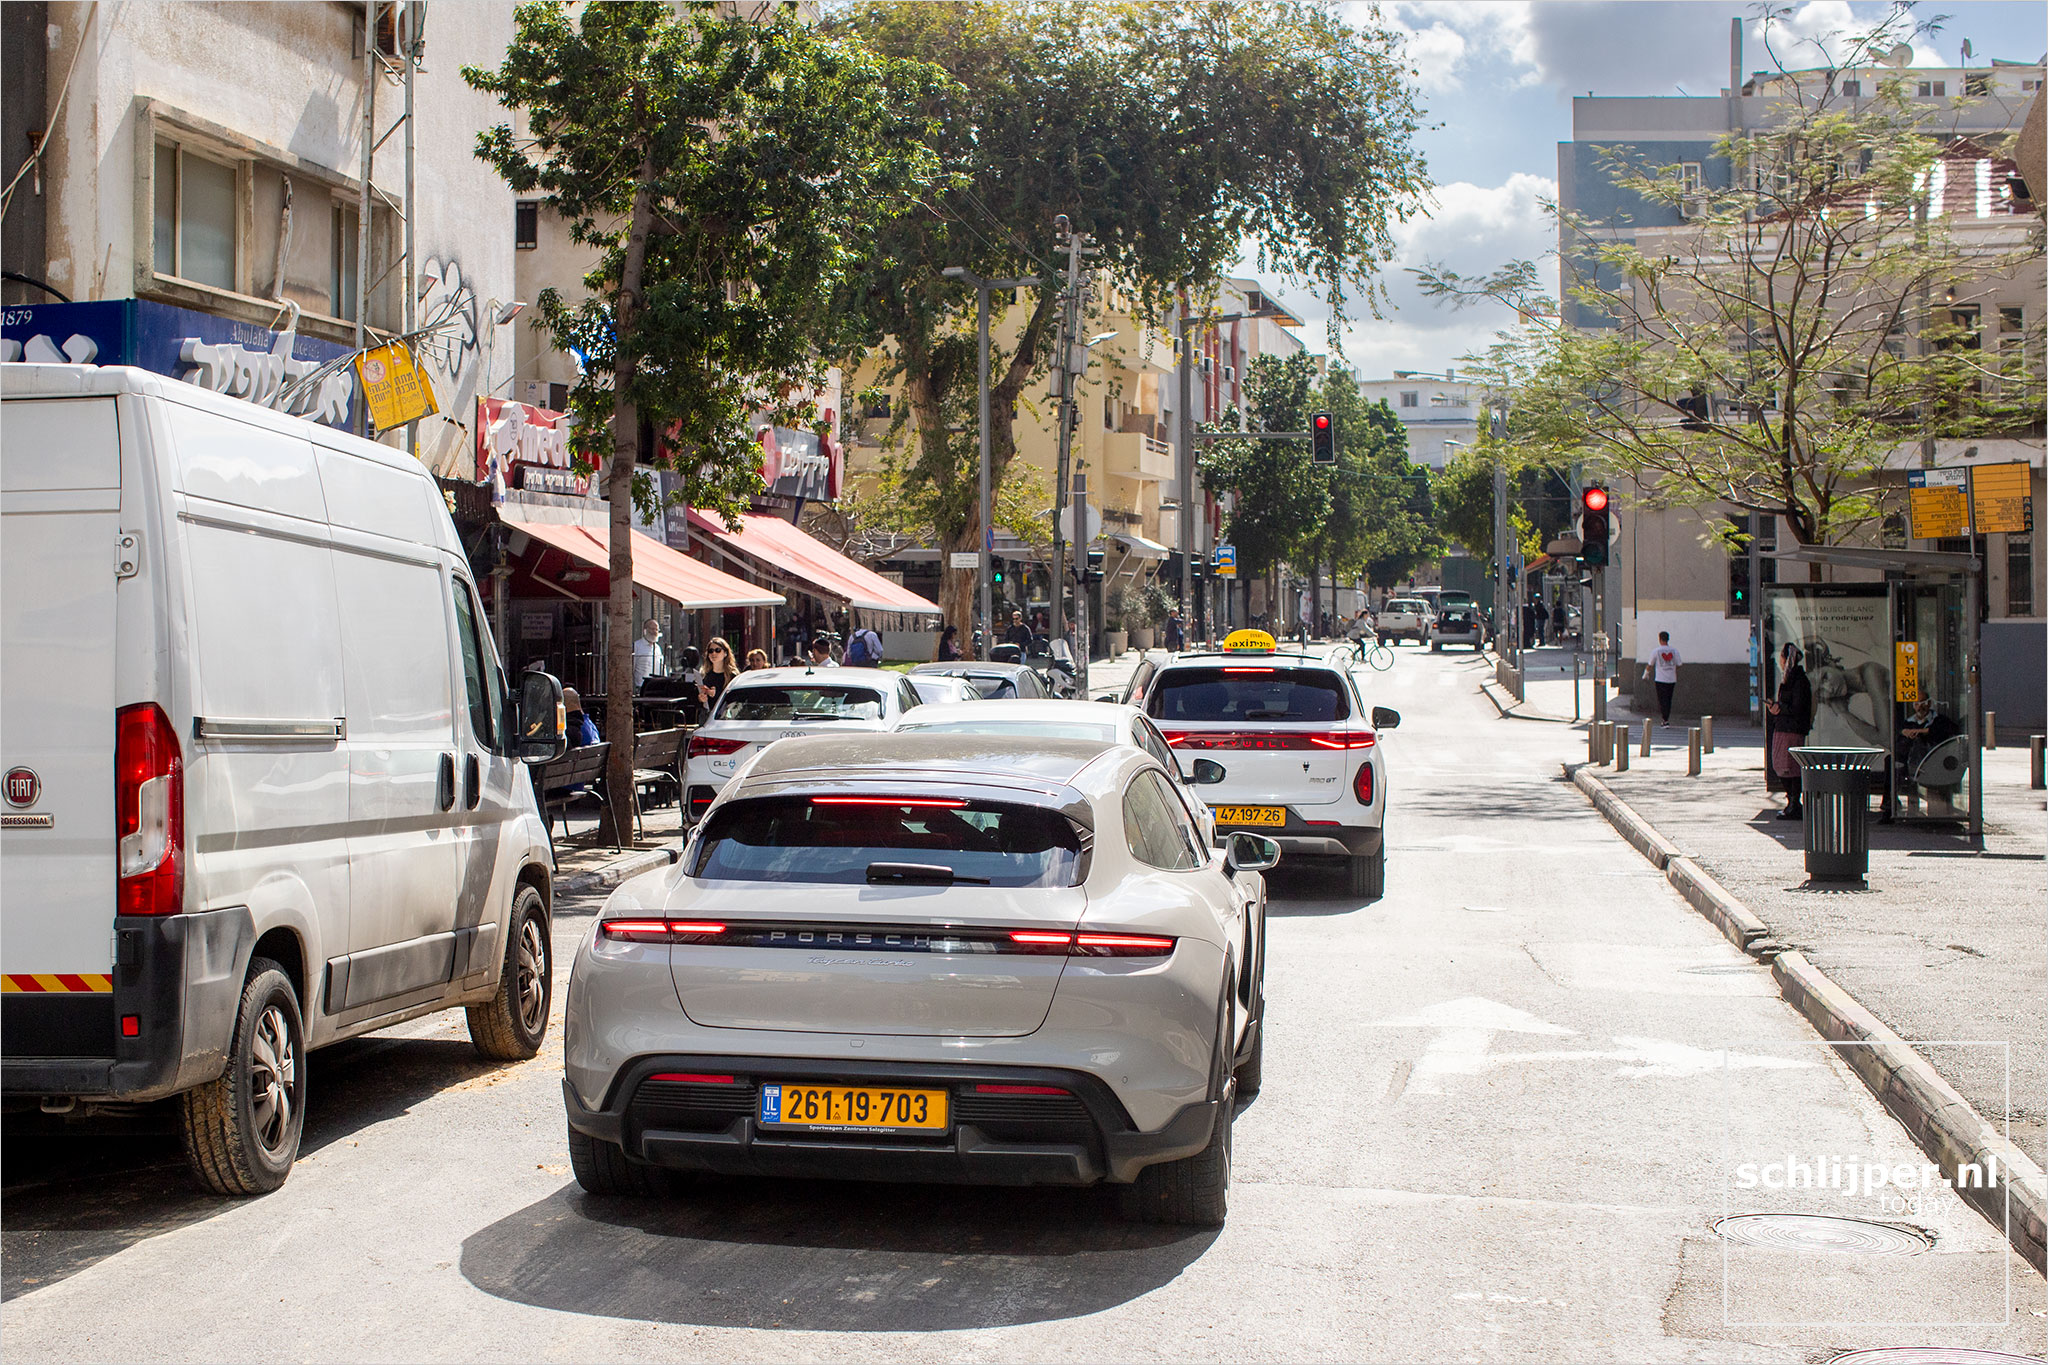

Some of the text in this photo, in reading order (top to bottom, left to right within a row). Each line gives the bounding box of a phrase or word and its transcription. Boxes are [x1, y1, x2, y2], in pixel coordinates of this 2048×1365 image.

[231, 323, 269, 348] Abulafia
[1905, 667, 1915, 676] 31
[1900, 679, 1916, 689] 104
[1901, 691, 1916, 700] 168
[1205, 740, 1289, 748] SKYWELL
[10, 779, 32, 797] FIAT
[1, 817, 48, 825] ROFESSIONAL
[770, 931, 961, 948] PORSCHE
[766, 1096, 777, 1111] IL
[809, 1124, 843, 1132] Sportwagen
